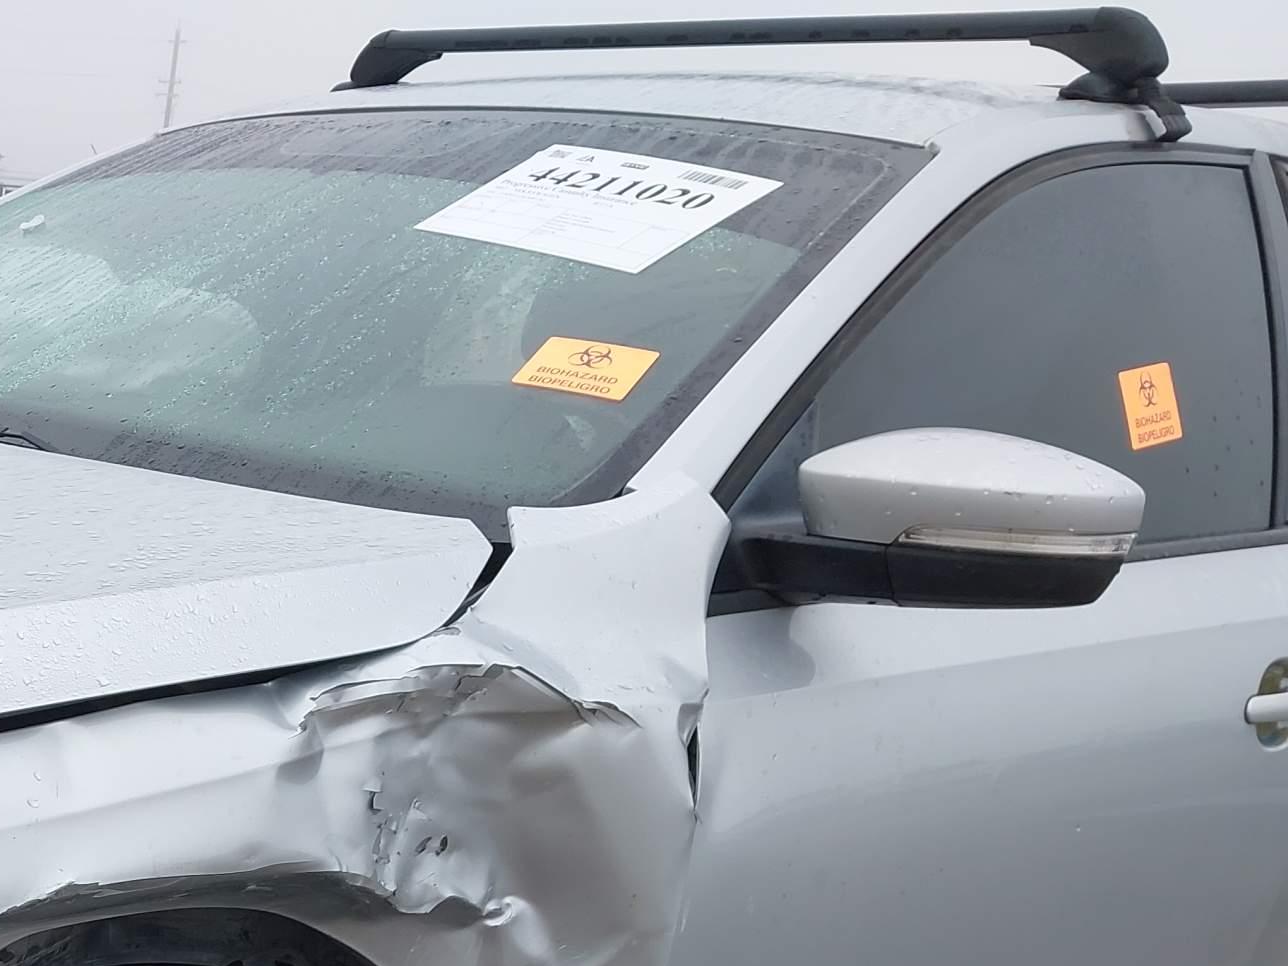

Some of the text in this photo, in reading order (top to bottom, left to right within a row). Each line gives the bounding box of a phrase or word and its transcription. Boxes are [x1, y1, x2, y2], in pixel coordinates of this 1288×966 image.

[528, 166, 716, 210] 44211020
[528, 375, 611, 394] BIOPELIGRO
[536, 366, 619, 385] BIOHAZARD
[1135, 410, 1172, 428] BIOHAZARD
[1138, 425, 1175, 444] BIOPELIGRO
